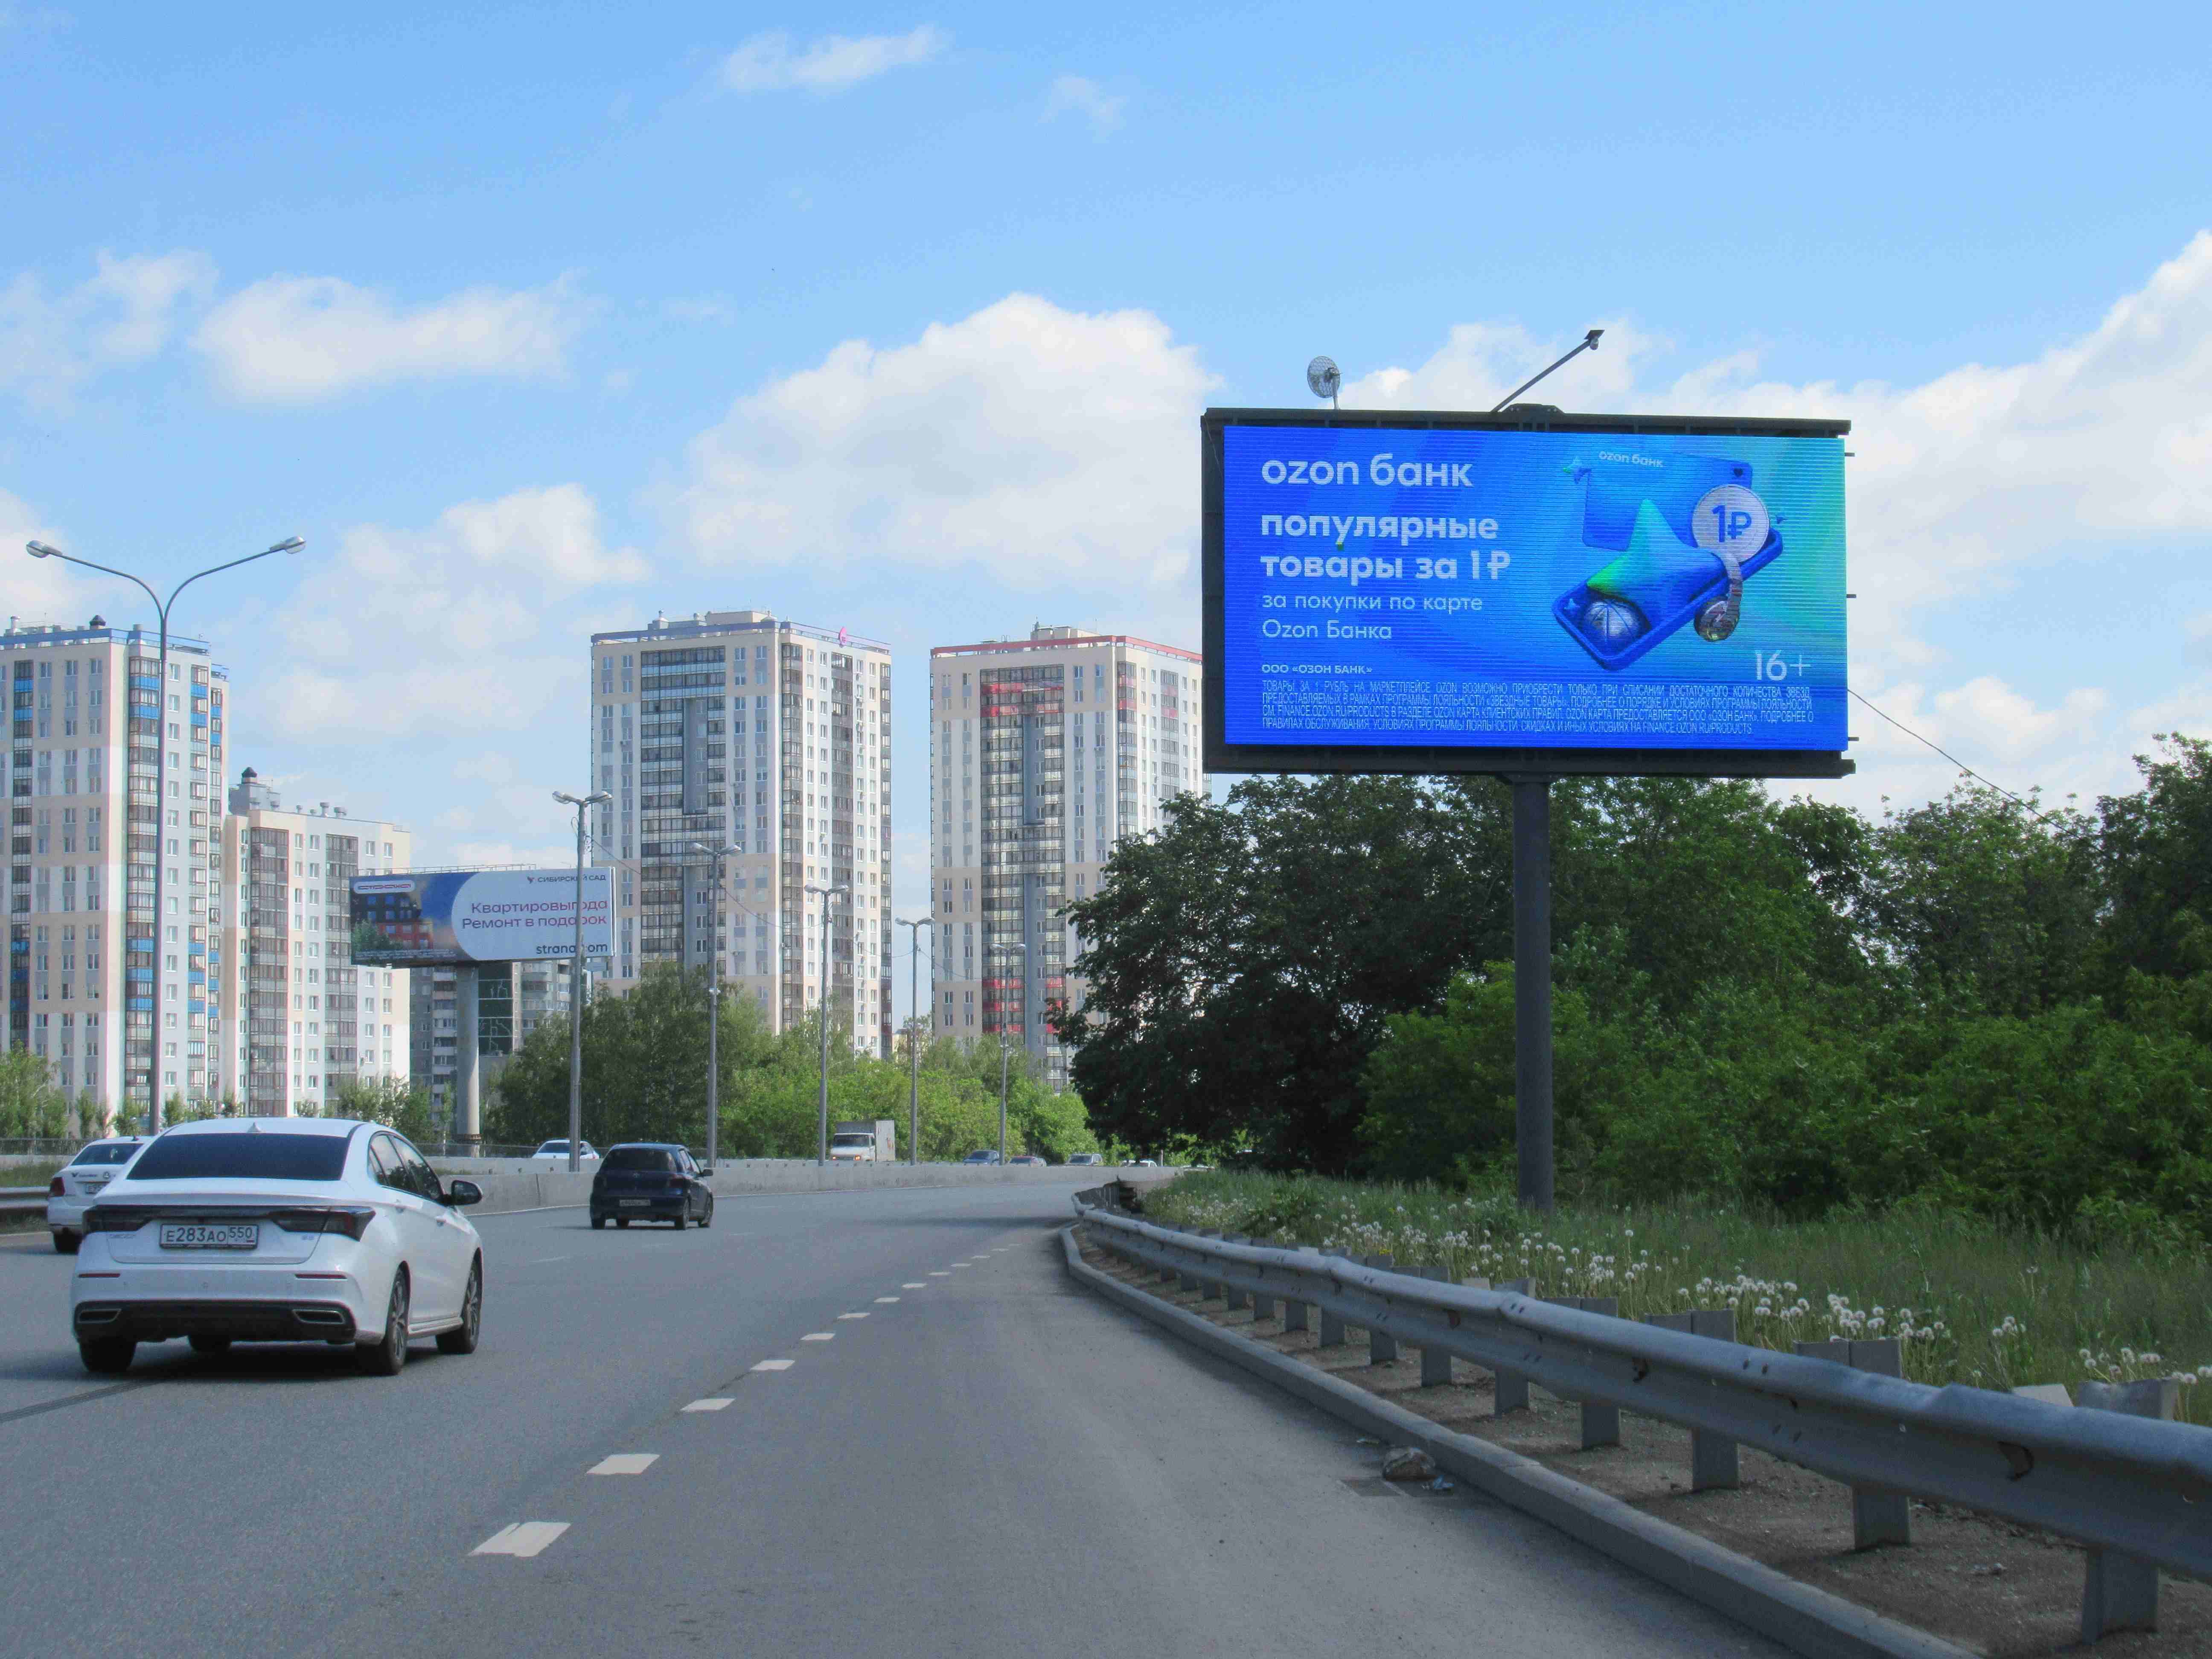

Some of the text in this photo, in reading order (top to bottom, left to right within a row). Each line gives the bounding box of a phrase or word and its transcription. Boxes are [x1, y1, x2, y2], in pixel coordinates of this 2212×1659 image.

[1598, 451, 1664, 467] ozon банк
[1262, 453, 1474, 487] ozon банк
[1261, 515, 1499, 546] популярные
[1260, 556, 1403, 586] товары
[1415, 558, 1458, 579] за
[1262, 595, 1483, 614] за покупки по карте
[1262, 619, 1392, 639] Ozon Банка
[1261, 664, 1373, 675] ООО «ОЗОН БАНК»
[1755, 649, 1811, 681] 16+
[1262, 680, 1295, 691] ТОВАРЫ
[1324, 681, 1349, 692] РУБЛЬ
[1567, 684, 1597, 695] ТОЛЬКО
[538, 874, 587, 883] СИБИРСКЙ
[462, 918, 521, 929] Ремонт
[536, 944, 608, 955] stranaom
[229, 1227, 253, 1238] 550
